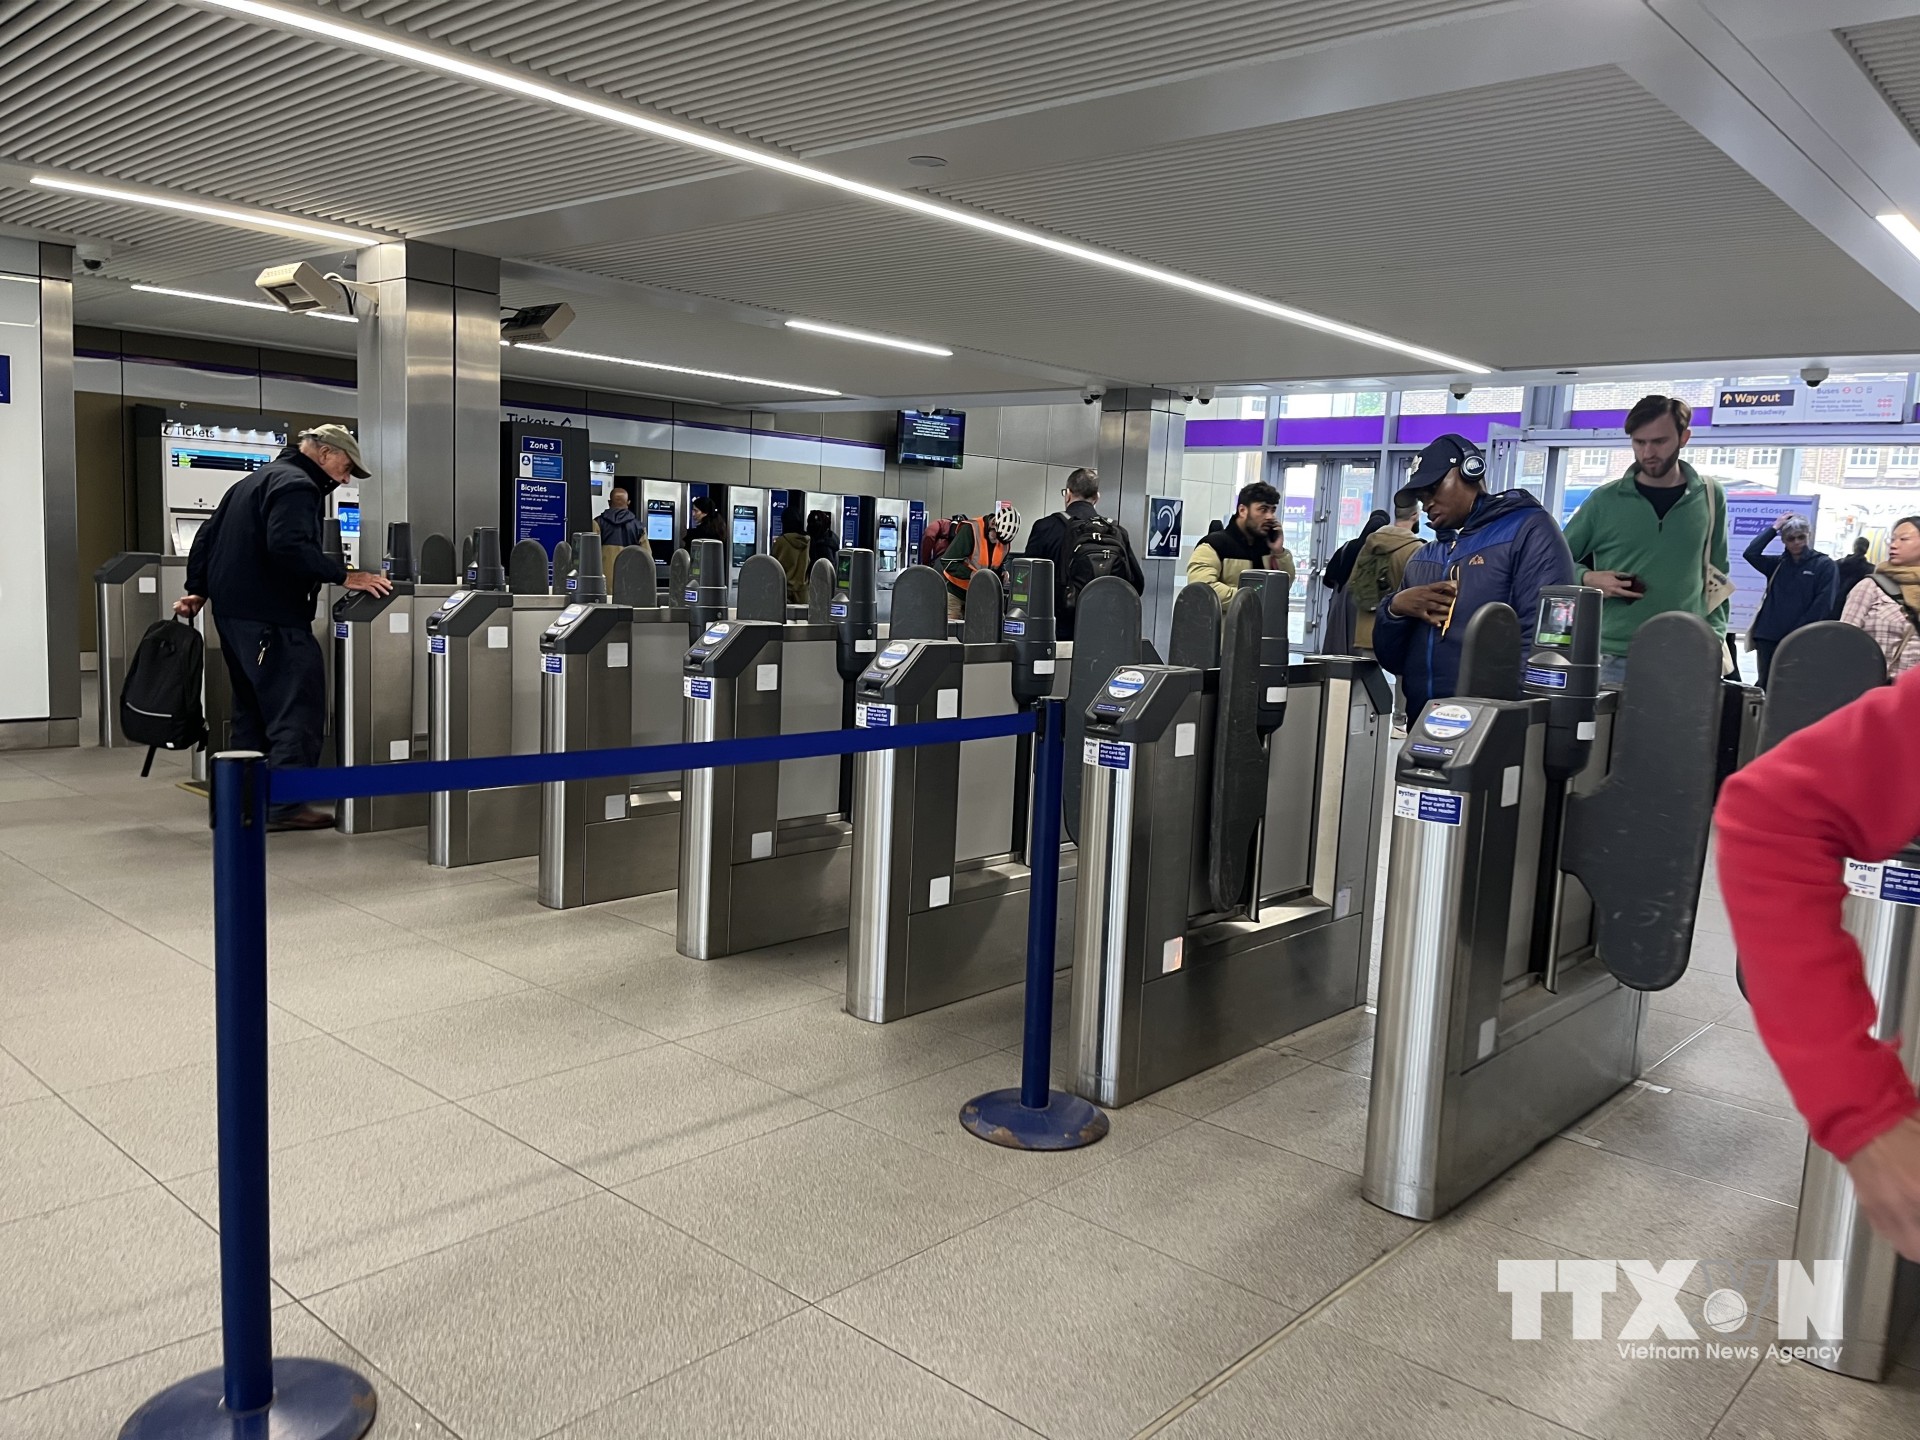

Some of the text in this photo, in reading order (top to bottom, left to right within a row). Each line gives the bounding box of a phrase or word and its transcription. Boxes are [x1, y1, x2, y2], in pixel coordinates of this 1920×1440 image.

[1734, 393, 1780, 404] Way out
[506, 413, 555, 426] Tickets
[176, 426, 215, 438] Tickets
[530, 441, 548, 450] Zone
[520, 484, 547, 492] Bicycles
[1171, 536, 1176, 546] T
[1849, 862, 1878, 872] oyster
[1886, 869, 1909, 877] Please
